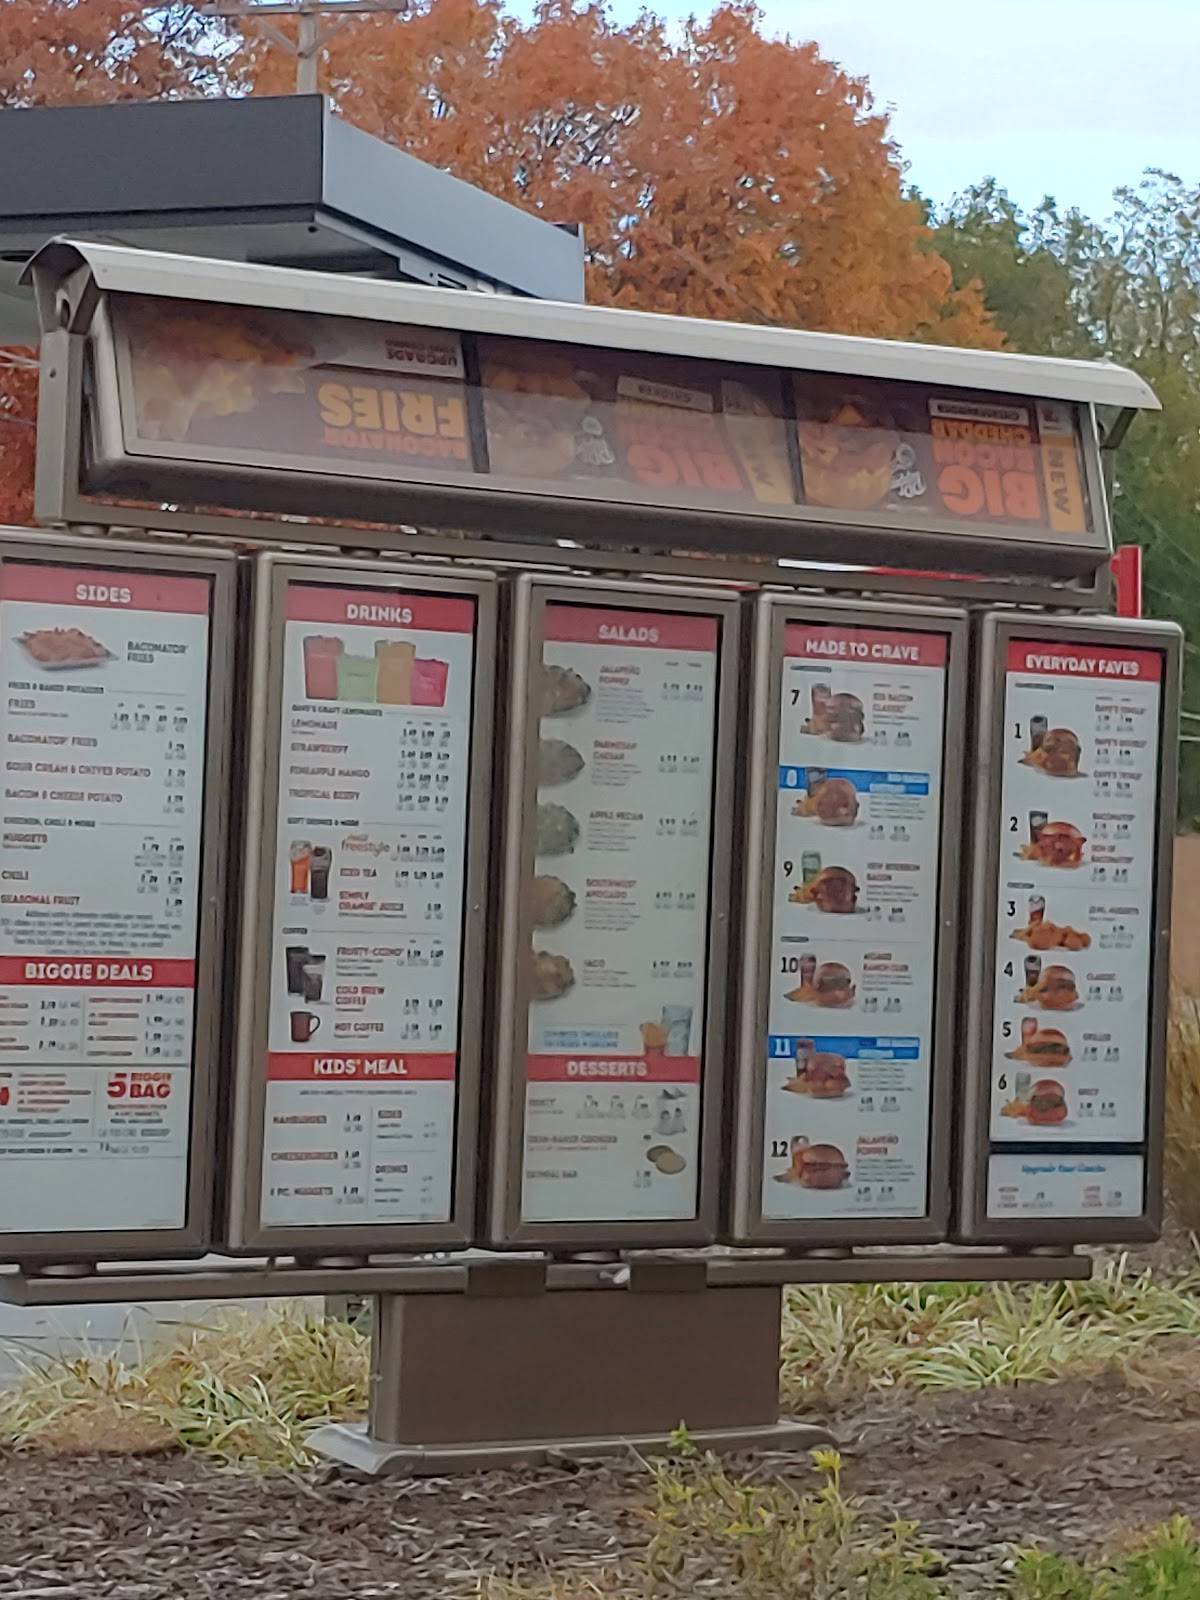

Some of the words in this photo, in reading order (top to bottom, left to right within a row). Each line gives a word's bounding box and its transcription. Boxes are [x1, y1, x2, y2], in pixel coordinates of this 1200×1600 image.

[318, 383, 465, 438] FRIES
[937, 464, 1040, 519] BIG
[76, 584, 131, 603] SIDES
[347, 603, 413, 624] DRINKS
[598, 624, 660, 643] SALADS
[806, 639, 847, 654] MADE
[850, 642, 869, 657] TO
[872, 644, 919, 660] CRAVE
[1026, 654, 1096, 672] EVERYDAY
[1098, 659, 1139, 675] FAVES
[790, 689, 800, 705] 7
[1014, 723, 1022, 739] 1
[1010, 817, 1018, 832] 2
[783, 861, 793, 877] 9
[1007, 901, 1016, 917] 3
[25, 963, 92, 979] BIGGIE
[96, 964, 153, 981] DEALS
[780, 957, 799, 973] 10
[1004, 962, 1013, 978] 4
[1002, 1021, 1011, 1037] 5
[775, 1039, 791, 1056] 11
[364, 1059, 407, 1076] MEAL
[567, 1061, 648, 1076] DESSERTS
[107, 1072, 127, 1098] 5
[998, 1073, 1007, 1090] 6
[129, 1083, 171, 1098] BAG
[771, 1140, 788, 1157] 12
